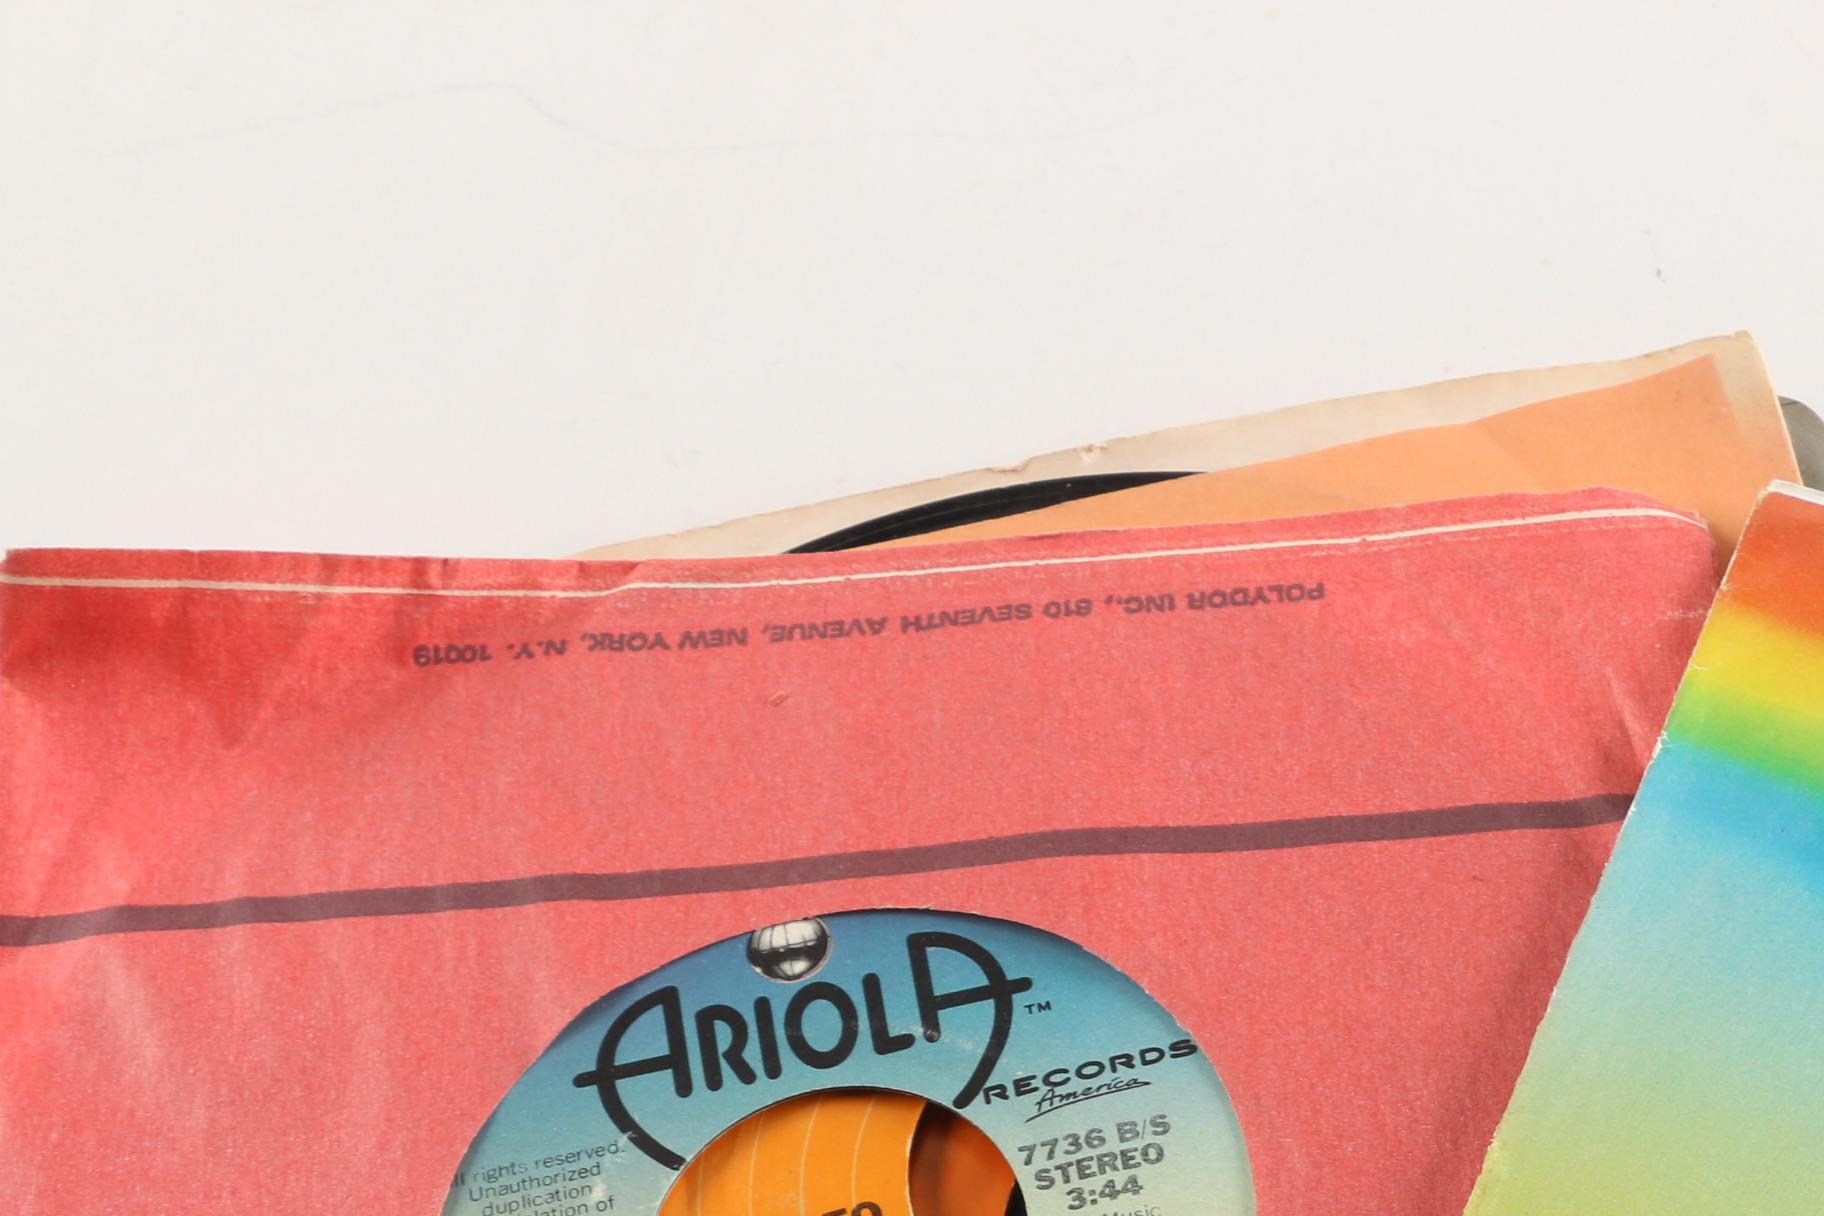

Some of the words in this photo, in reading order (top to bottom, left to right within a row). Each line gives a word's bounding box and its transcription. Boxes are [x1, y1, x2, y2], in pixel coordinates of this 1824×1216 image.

[1043, 598, 1093, 619] 810
[1186, 582, 1325, 611] POLYDOR
[762, 615, 888, 643] AVENUE,
[901, 604, 1033, 633] SEVENTH
[507, 639, 568, 661] N.Y.
[580, 632, 670, 653] YORK,
[677, 626, 750, 649] NEW
[413, 643, 492, 667] 10019
[572, 931, 1033, 1170] ARIOLA
[983, 1037, 1199, 1105] RECORDS
[1018, 1128, 1106, 1167] 7736
[1117, 1114, 1172, 1142] B/S
[473, 1159, 529, 1187] rights
[534, 1140, 627, 1170] reserved.
[1034, 1142, 1165, 1191] STEREO
[468, 1161, 602, 1202] Unauthorized
[1066, 1174, 1143, 1211] 3:44
